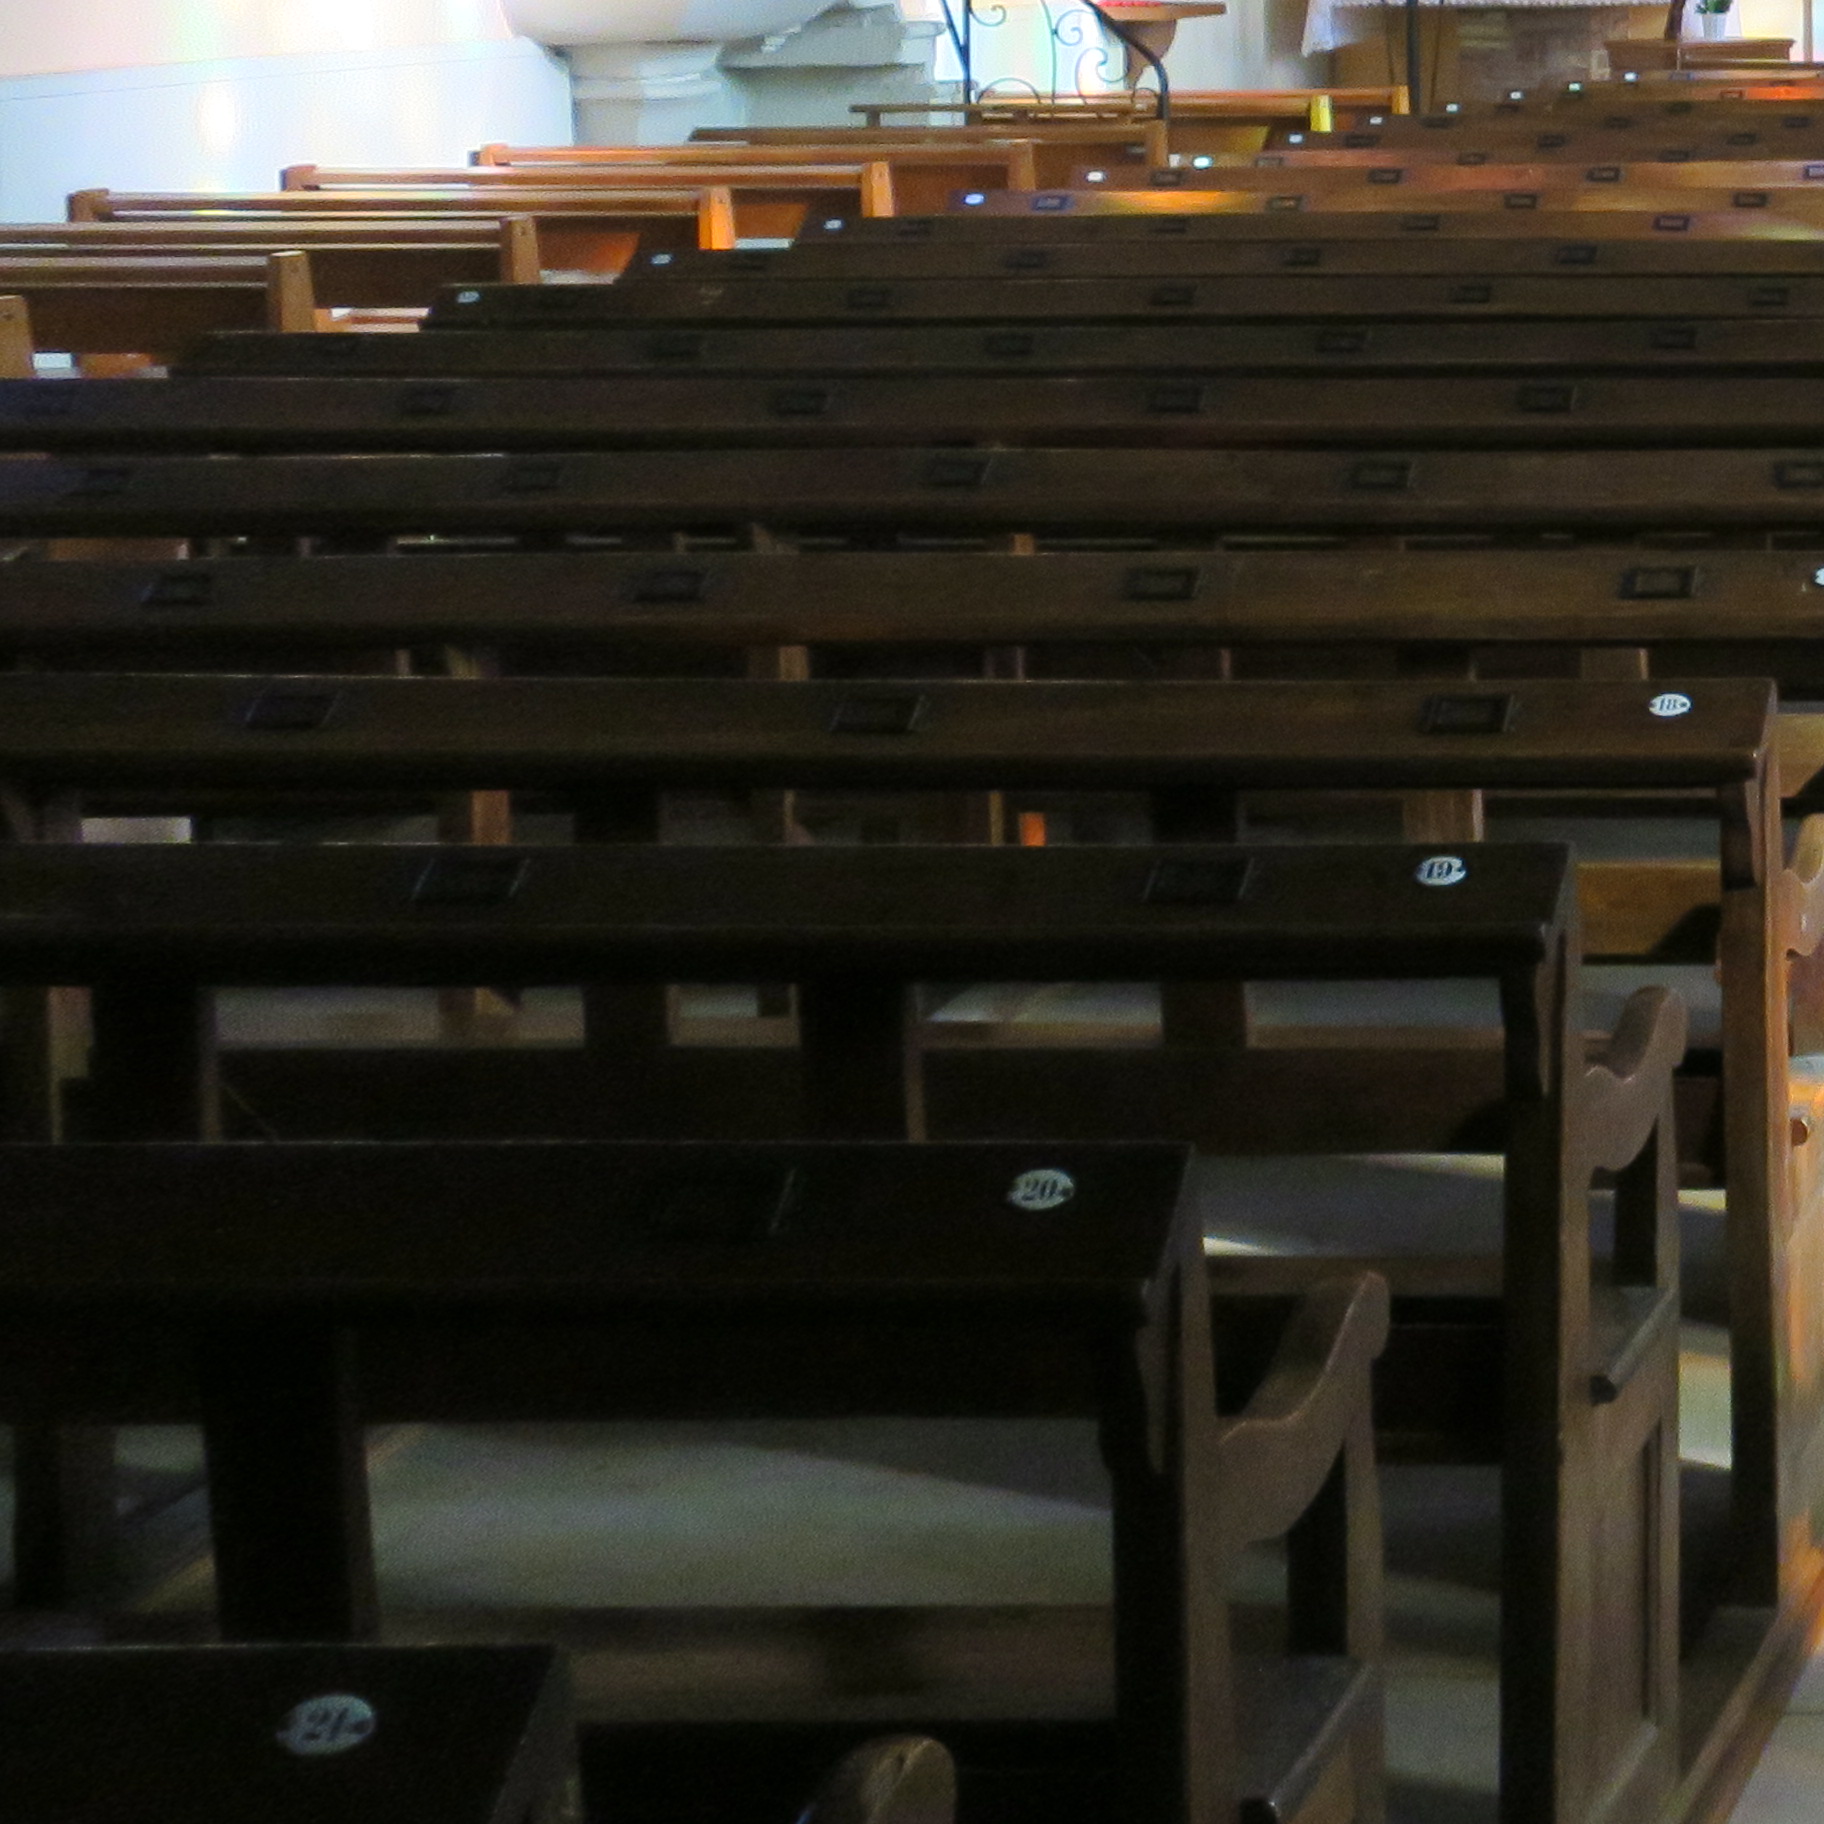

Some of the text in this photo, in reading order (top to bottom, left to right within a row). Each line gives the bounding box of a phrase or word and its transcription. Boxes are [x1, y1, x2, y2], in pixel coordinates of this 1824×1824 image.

[1657, 696, 1679, 711] 18
[1425, 860, 1454, 882] 19
[1021, 1178, 1059, 1202] 20
[304, 1708, 350, 1742] 21
